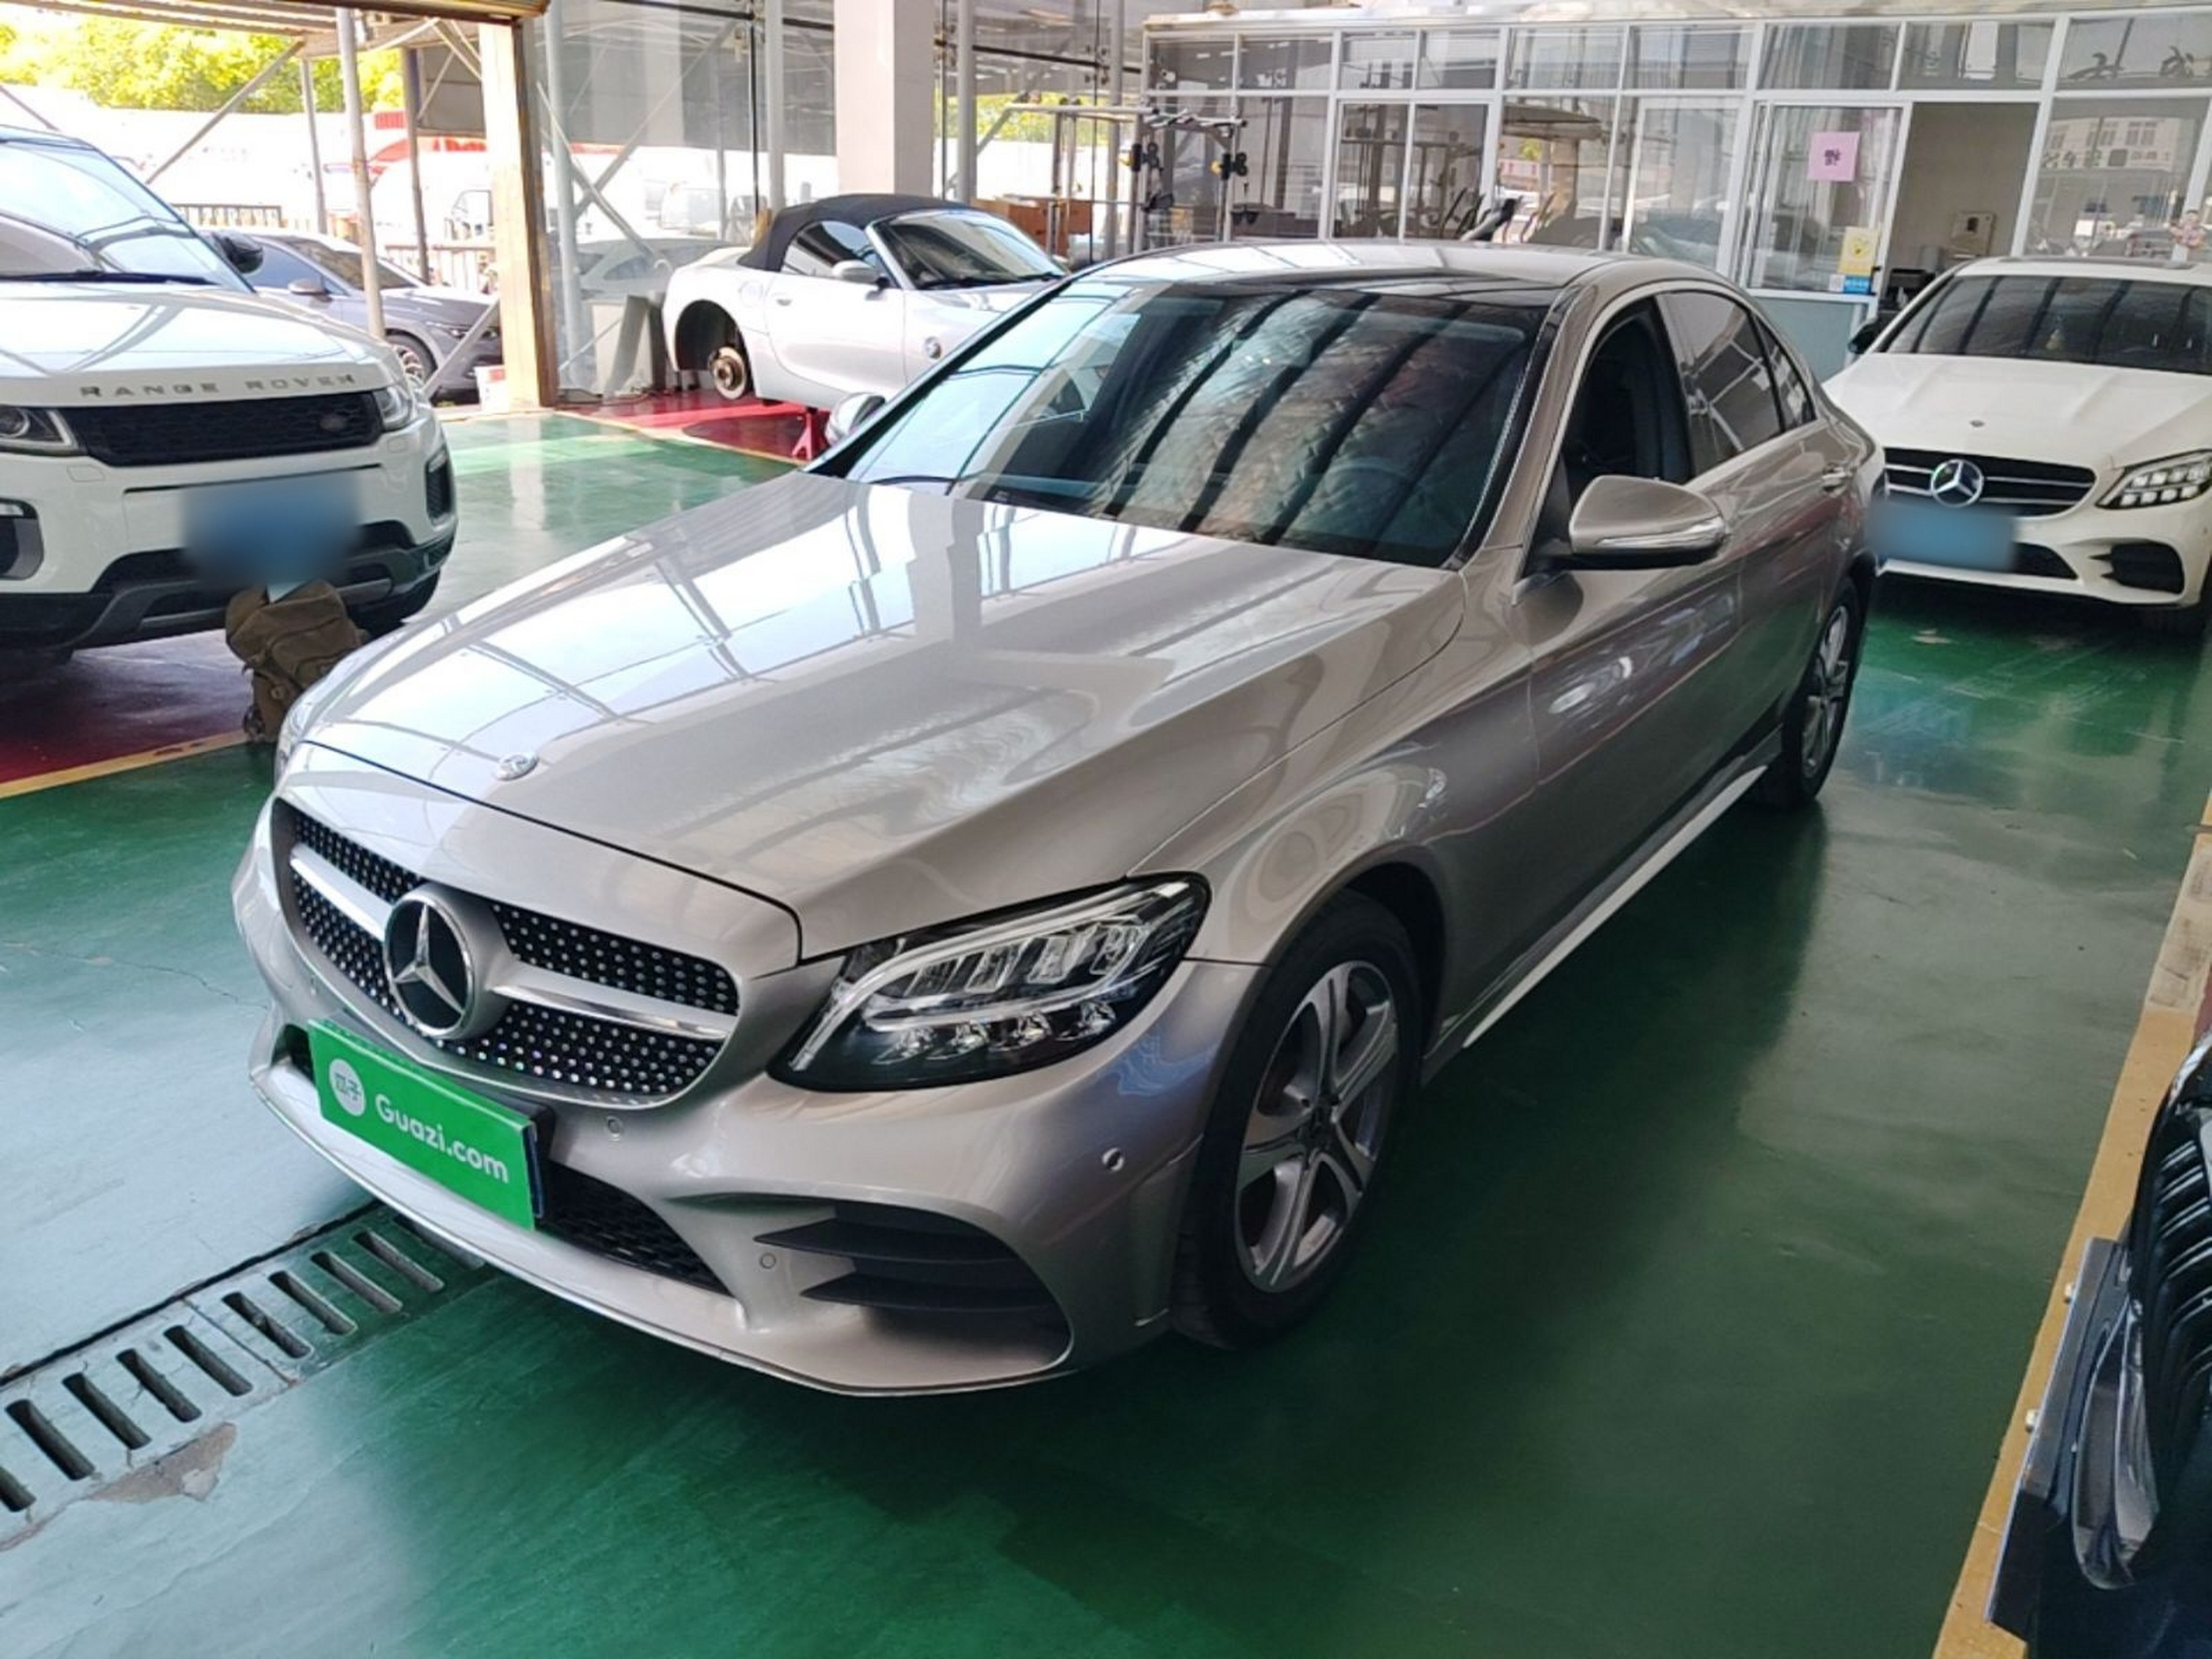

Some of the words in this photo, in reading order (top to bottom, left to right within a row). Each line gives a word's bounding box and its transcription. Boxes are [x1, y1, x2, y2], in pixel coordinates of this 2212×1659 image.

[79, 382, 219, 397] RANGE
[245, 374, 356, 391] ROVER
[375, 1093, 509, 1184] Guazi.com
